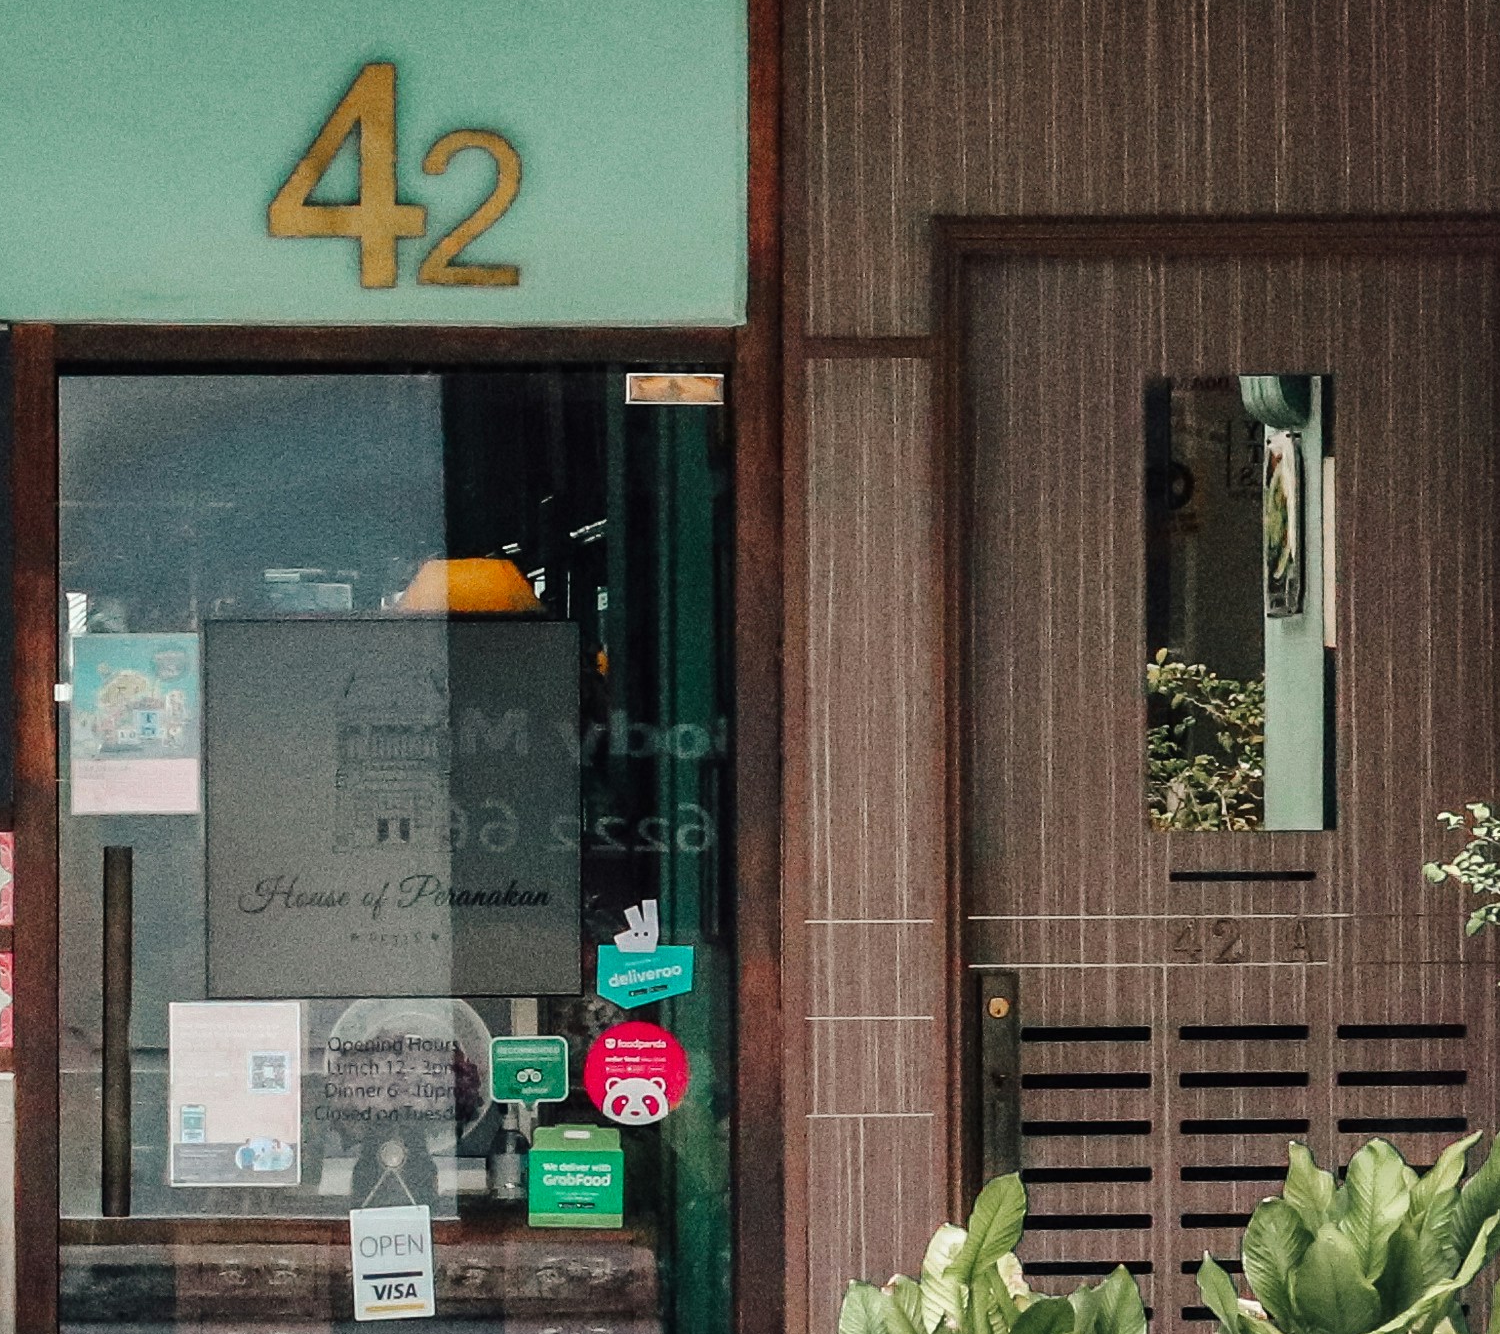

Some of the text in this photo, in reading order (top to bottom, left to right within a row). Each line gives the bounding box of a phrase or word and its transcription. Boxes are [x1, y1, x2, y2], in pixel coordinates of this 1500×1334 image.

[267, 62, 523, 289] 42
[238, 874, 550, 919] House of Peranakan
[608, 965, 682, 988] deliveroo
[327, 1036, 460, 1055] Opening Hours
[327, 1059, 380, 1076] Lunch
[387, 1060, 407, 1076] 12
[324, 1082, 382, 1099] Dinner
[386, 1082, 398, 1098] 6
[314, 1105, 372, 1121] Closed
[378, 1108, 398, 1121] on
[542, 1163, 558, 1172] We
[542, 1172, 612, 1186] GrabFood
[360, 1233, 424, 1258] OPEN
[372, 1283, 417, 1300] VISA
